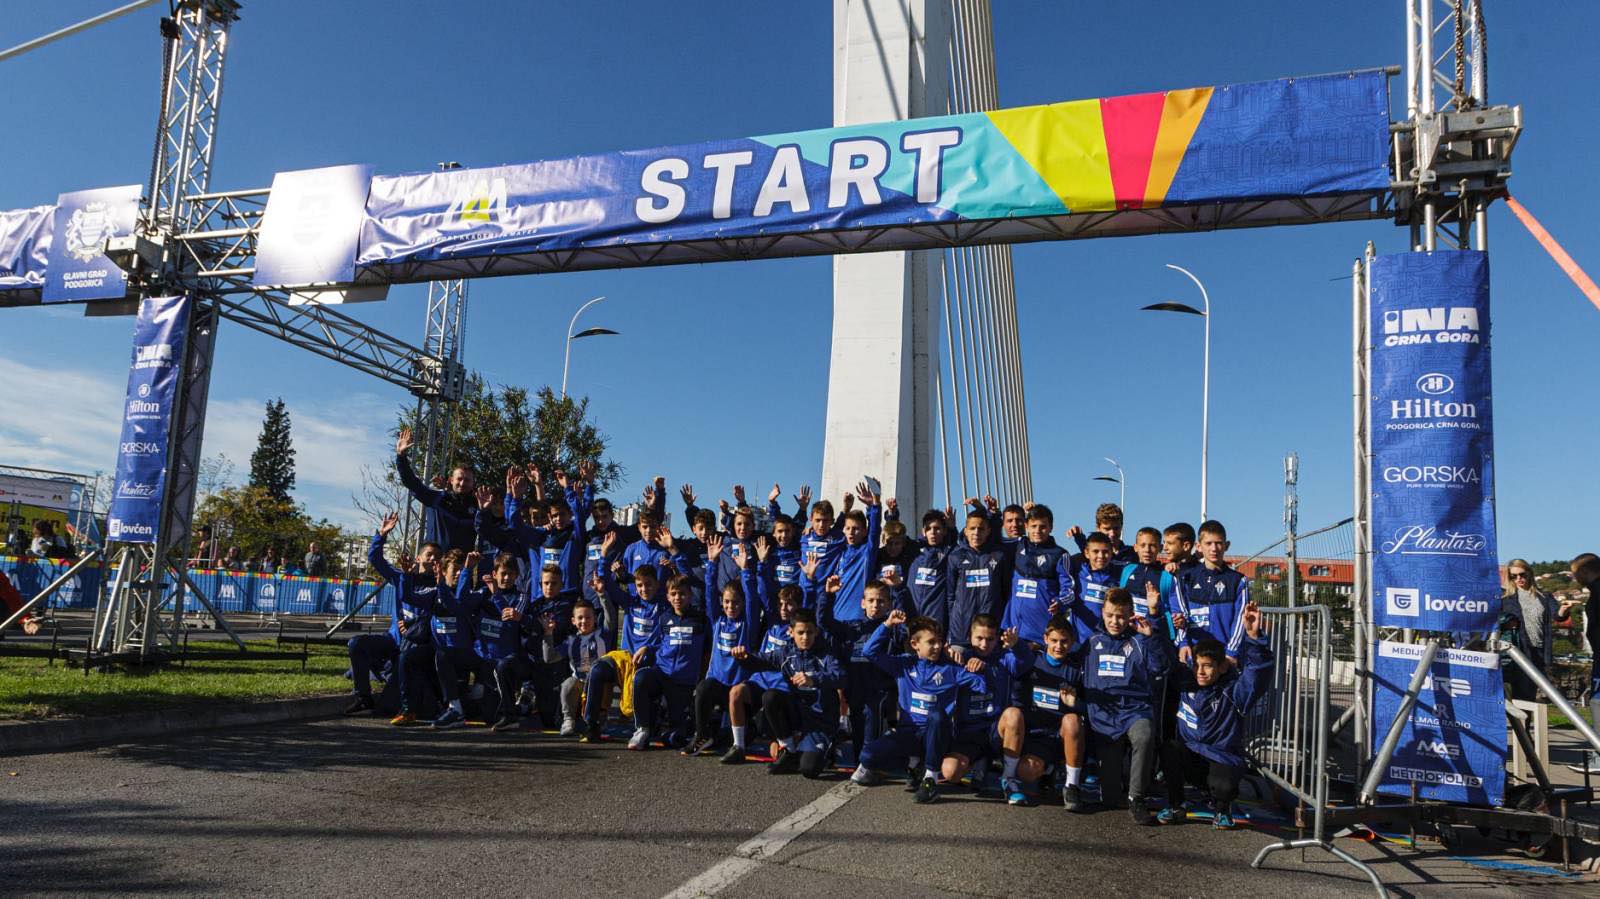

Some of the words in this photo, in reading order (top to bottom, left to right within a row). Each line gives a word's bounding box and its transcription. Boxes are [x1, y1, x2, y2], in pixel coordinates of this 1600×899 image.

[634, 129, 960, 223] START
[63, 271, 87, 280] GLAVNI
[87, 270, 107, 279] GRAD
[64, 279, 103, 288] PODGORICA
[1385, 334, 1432, 347] CRNA
[1435, 331, 1479, 344] GORA
[128, 400, 160, 413] Hilton
[1391, 399, 1476, 419] Hilton
[1386, 422, 1434, 430] PODGORICA
[1436, 421, 1459, 429] CRNA
[1460, 422, 1480, 430] GORA
[121, 442, 160, 453] GORSKA
[1383, 465, 1481, 484] GORSKA
[120, 523, 153, 535] lovćen
[1381, 524, 1487, 554] Plantaže
[1022, 584, 1027, 592] 1
[1424, 594, 1488, 613] lovćen
[1392, 647, 1425, 656] MEDIJS
[1106, 662, 1111, 670] 1
[1041, 694, 1046, 702] 1
[1409, 715, 1440, 725] ELMAG
[1442, 719, 1471, 729] RADIO
[1391, 766, 1482, 788] METROPOLIS
